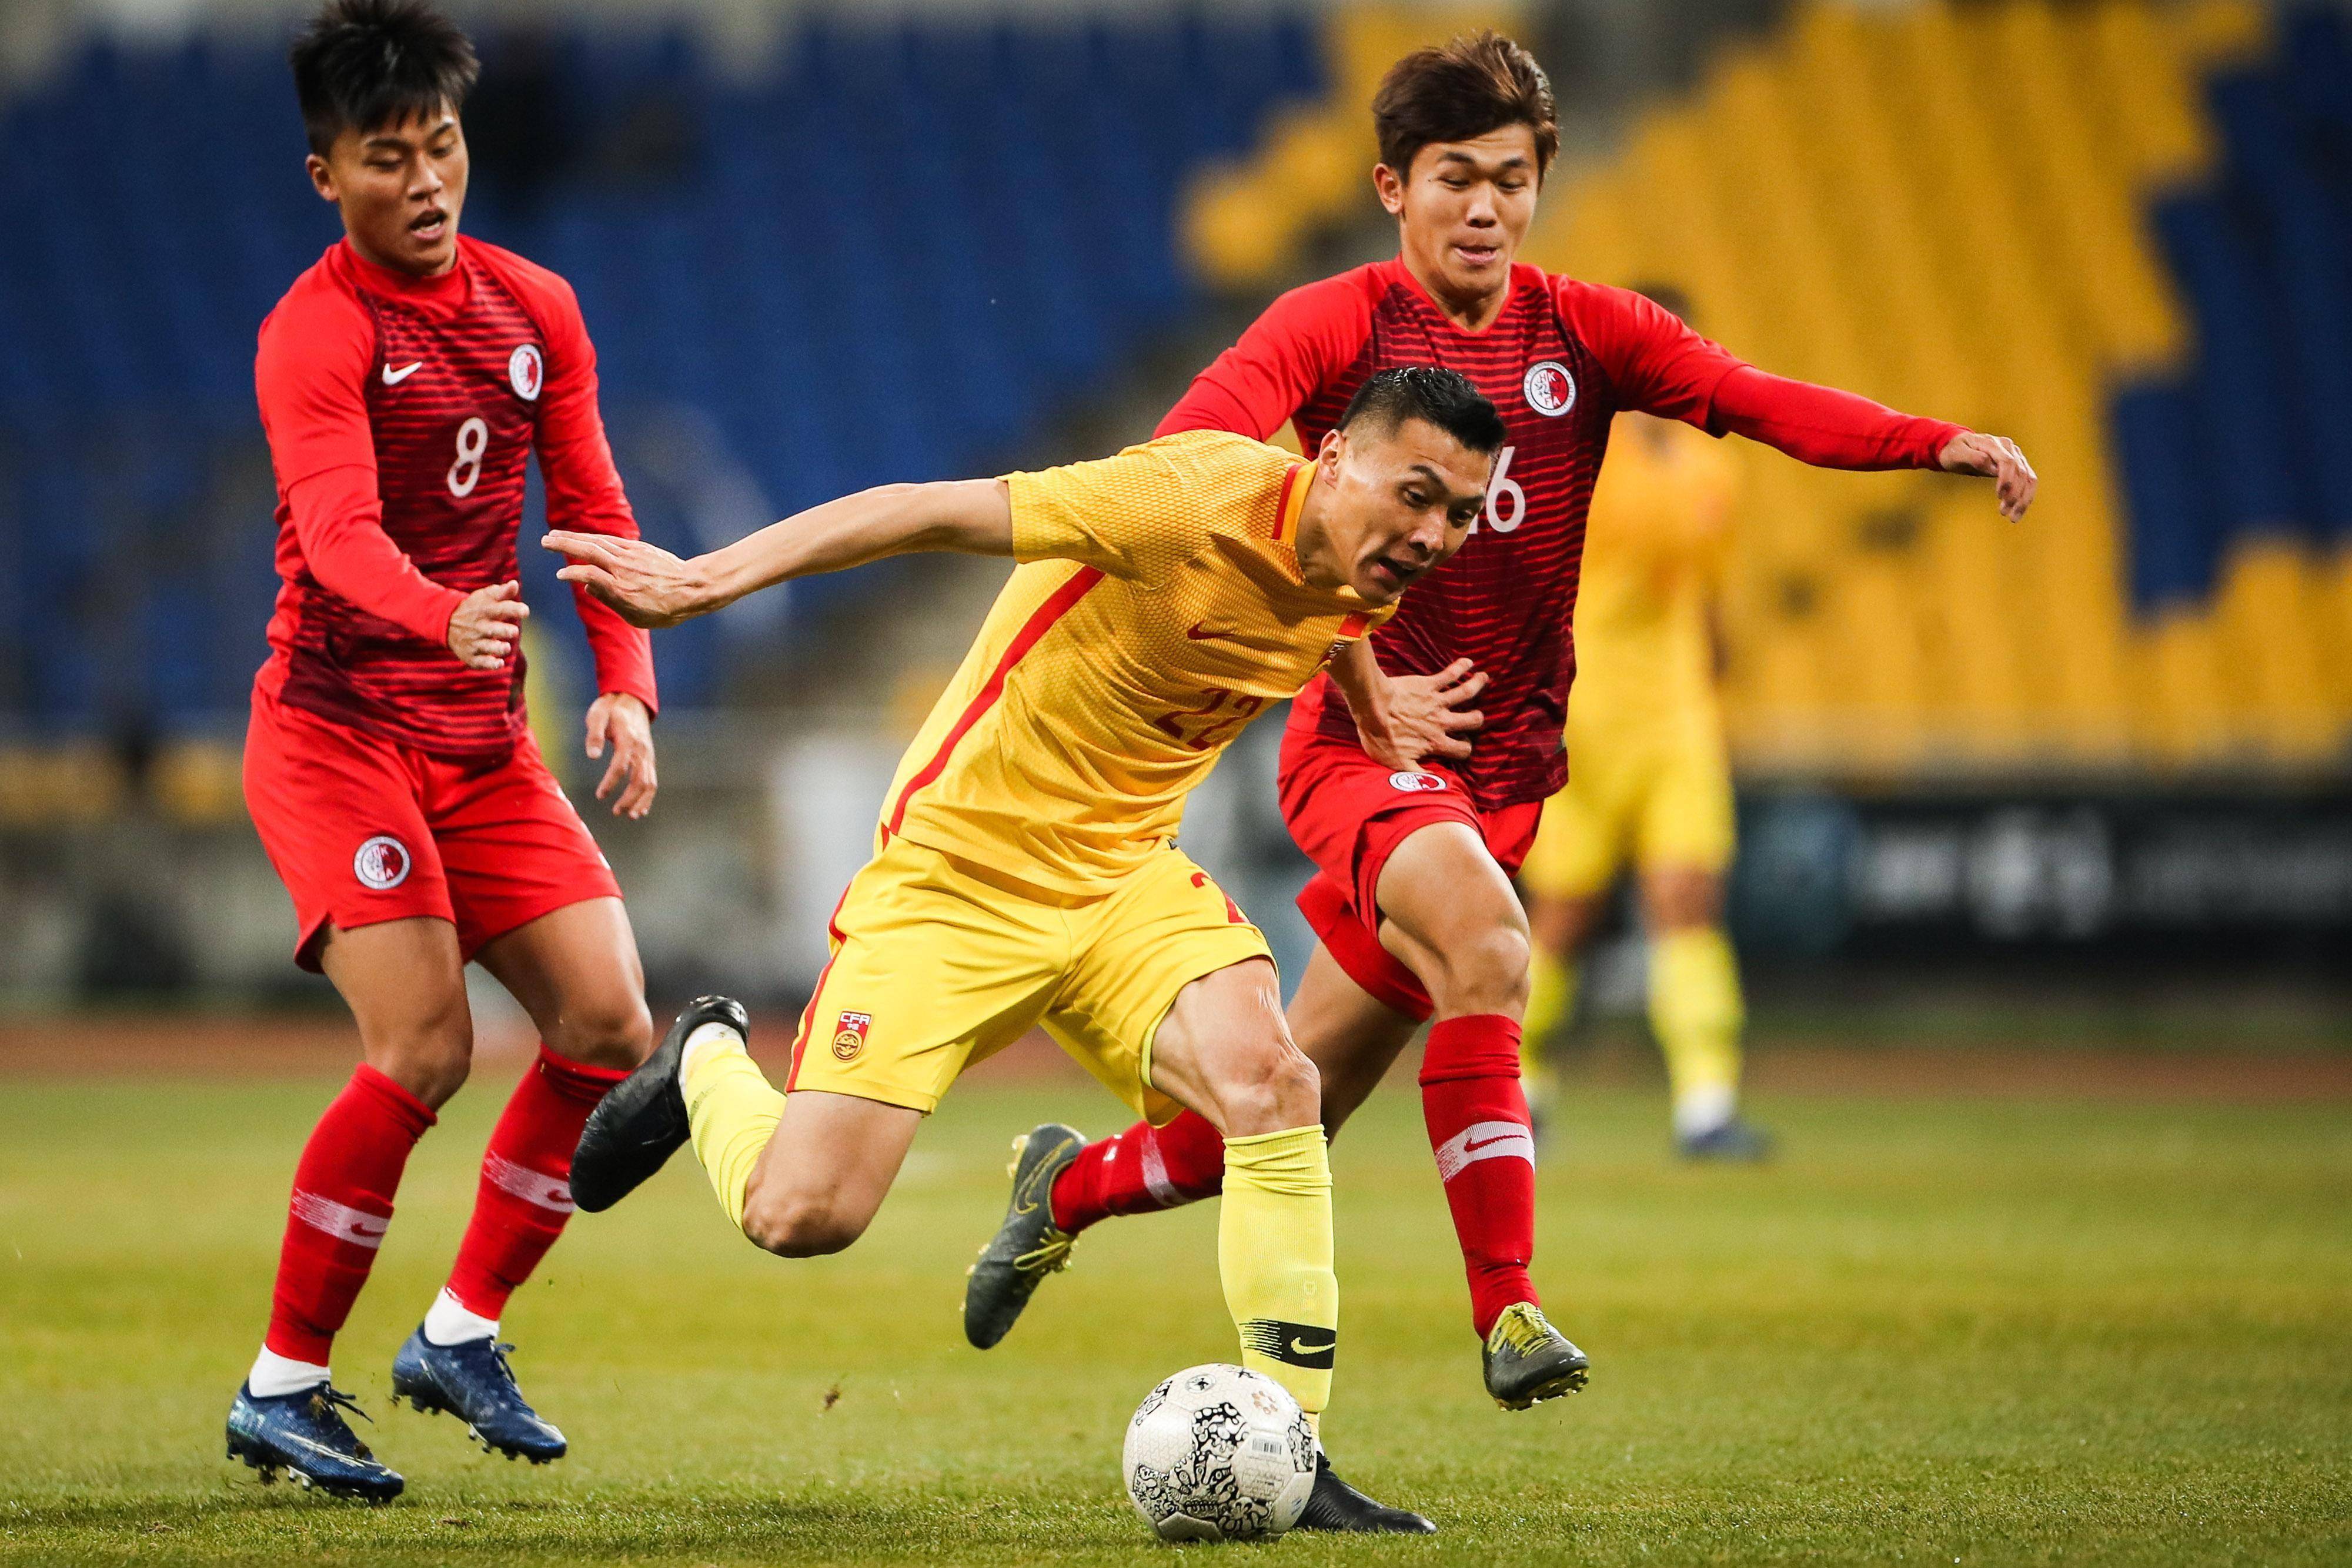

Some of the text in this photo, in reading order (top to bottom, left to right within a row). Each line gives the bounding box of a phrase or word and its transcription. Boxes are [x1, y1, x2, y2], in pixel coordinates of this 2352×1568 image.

[1539, 371, 1556, 383] HK
[446, 417, 489, 497] 8
[1468, 445, 1526, 536] 6
[1154, 687, 1264, 751] 22
[840, 1012, 870, 1025] CFA
